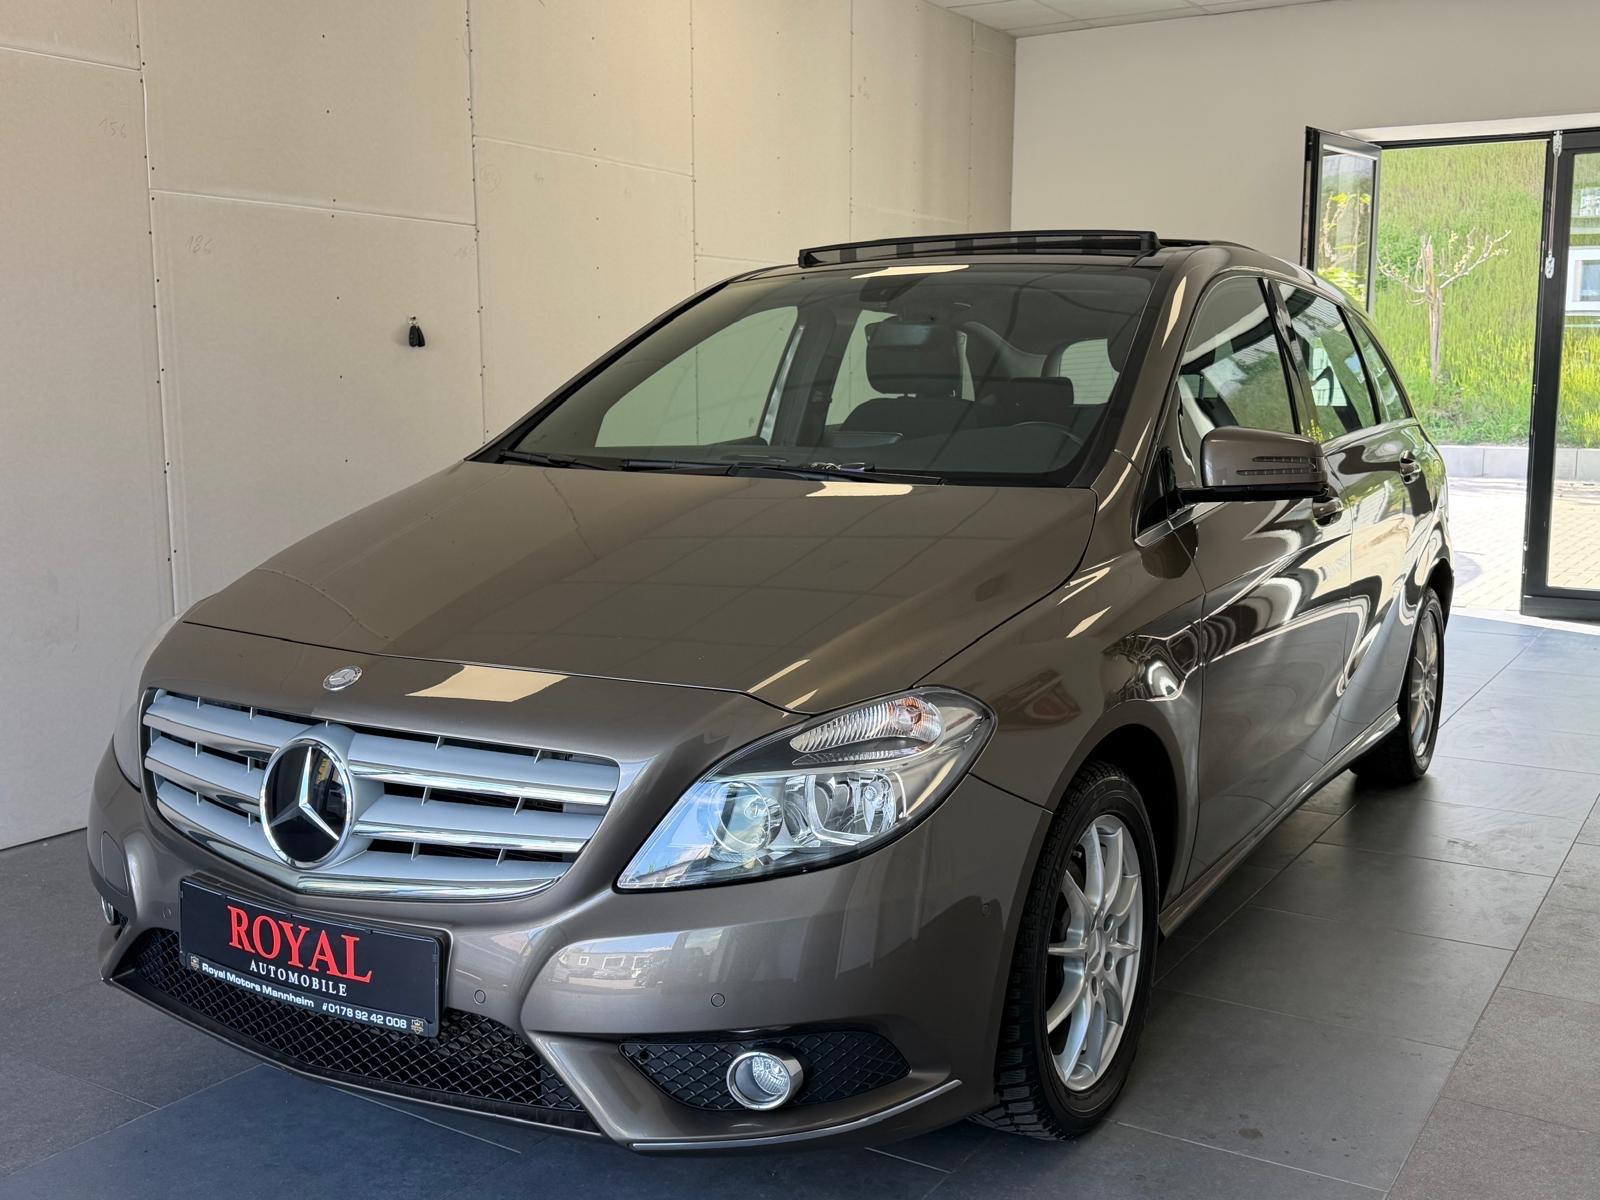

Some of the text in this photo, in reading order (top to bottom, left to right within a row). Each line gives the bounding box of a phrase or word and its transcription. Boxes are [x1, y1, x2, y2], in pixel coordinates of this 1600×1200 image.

[227, 905, 373, 983] ROYAL
[201, 962, 407, 1029] Royal Motors Mannheim #0178 92 42 008
[250, 959, 348, 997] AUTOMOBILE
